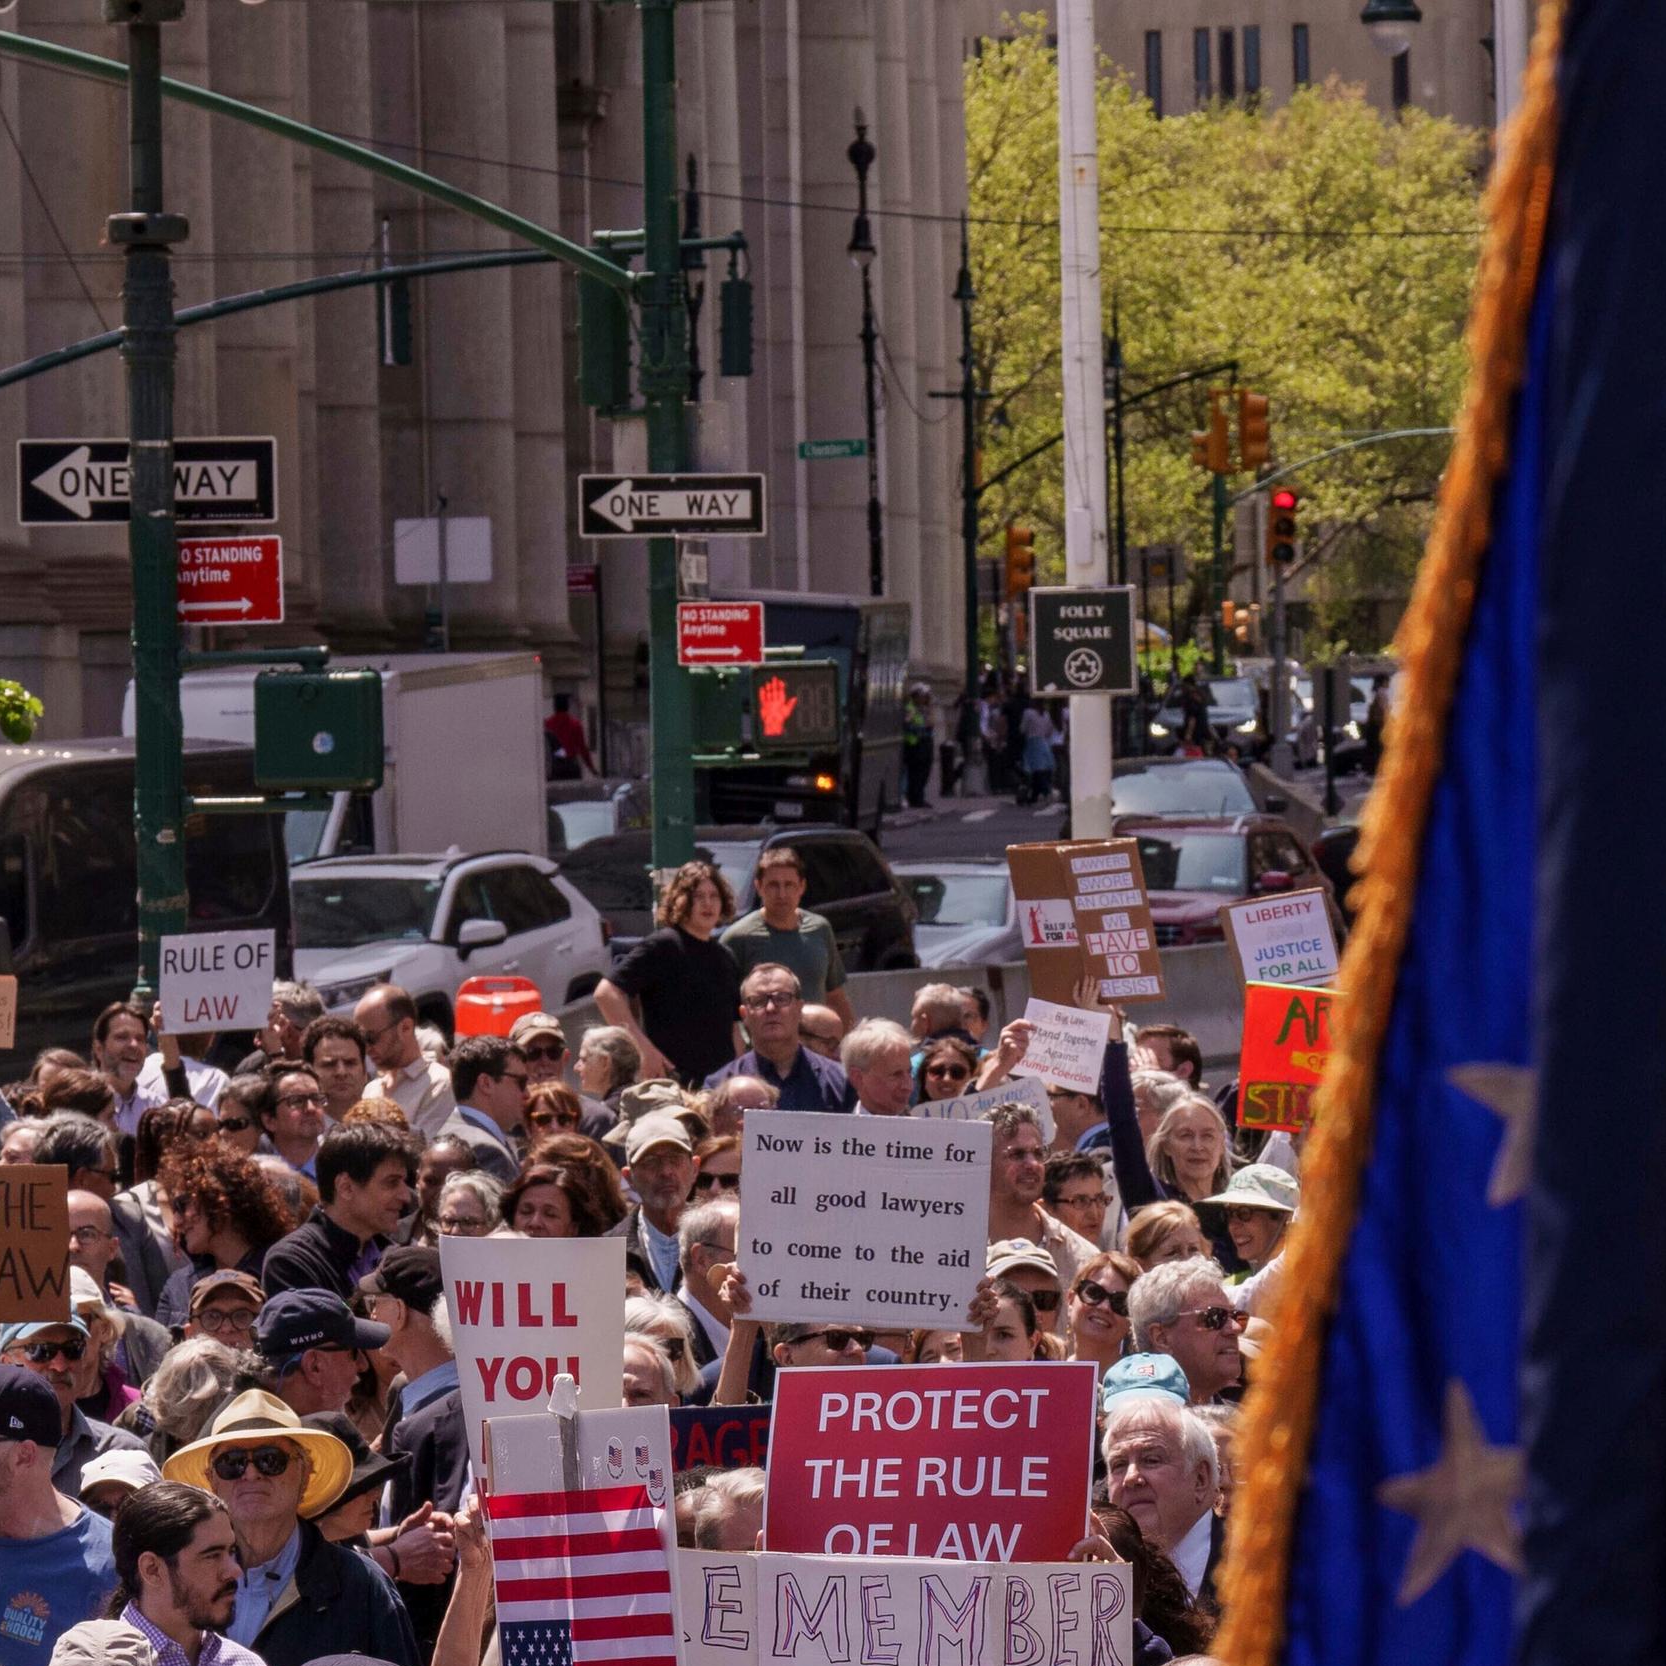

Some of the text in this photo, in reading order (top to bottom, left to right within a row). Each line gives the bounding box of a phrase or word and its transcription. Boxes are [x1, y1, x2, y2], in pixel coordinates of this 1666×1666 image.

[59, 465, 240, 497] ONE WAY
[609, 493, 740, 517] ONE WAY
[195, 545, 263, 563] STANDING
[682, 608, 749, 622] NO STANDING
[1059, 605, 1104, 619] FOLEY
[683, 622, 726, 637] Anytime
[1053, 626, 1112, 642] SQUARE
[1072, 854, 1130, 873] LAWYERS
[1078, 873, 1133, 891] SWORE
[1076, 894, 1099, 910] AN
[1245, 901, 1312, 924] LIBERTY
[1104, 914, 1130, 931] WE
[1087, 929, 1149, 954] HAVE
[1254, 938, 1323, 962] JUSTICE
[163, 943, 269, 975] RULE OF
[1108, 953, 1140, 975] TO
[1259, 957, 1327, 981] FOR ALL
[1101, 977, 1159, 997] RESIST
[183, 995, 239, 1024] LAW
[1062, 1031, 1099, 1047] Together
[1044, 1046, 1079, 1063] Against
[1052, 1065, 1093, 1084] Coercion
[756, 1134, 976, 1163] Now is the time for
[770, 1187, 965, 1218] all good lawyers
[752, 1238, 971, 1268] to come to the aid
[455, 1280, 578, 1327] WILL
[758, 1279, 960, 1311] of their country.
[476, 1356, 580, 1402] YOU
[819, 1388, 1051, 1432] PROTECT
[805, 1456, 1050, 1500] THE RULE
[824, 1522, 1023, 1562] OF LAW
